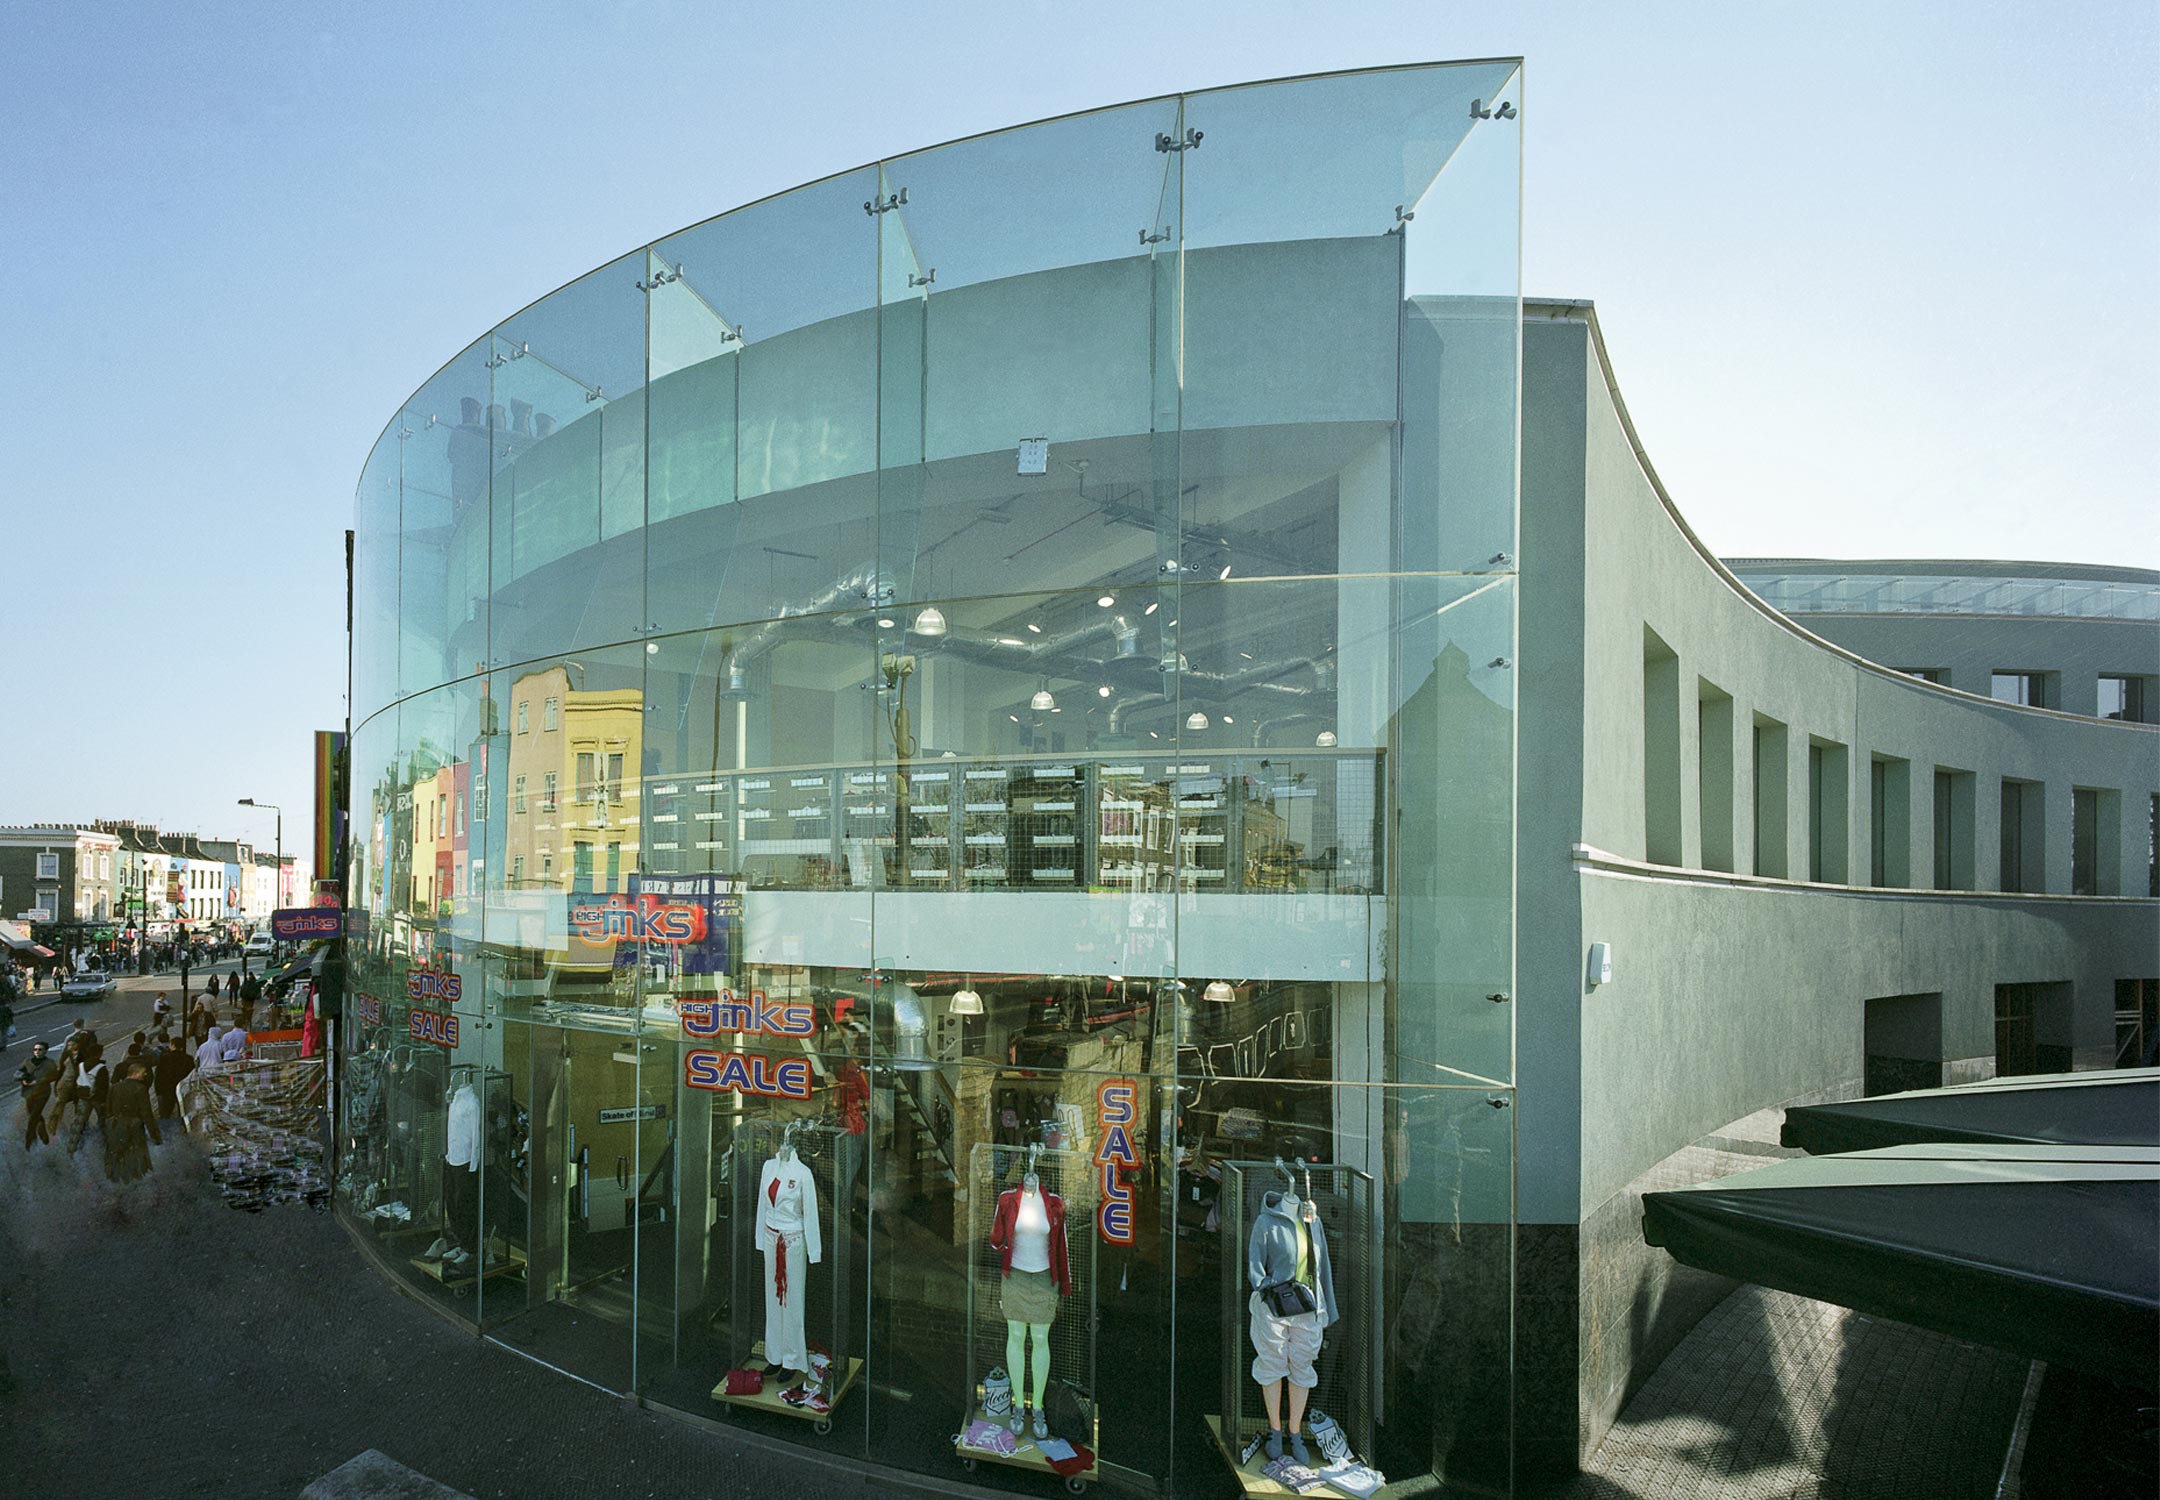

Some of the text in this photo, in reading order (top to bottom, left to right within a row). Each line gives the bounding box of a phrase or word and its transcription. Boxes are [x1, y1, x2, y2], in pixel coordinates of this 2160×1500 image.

[679, 1003, 713, 1014] HIGH
[411, 1012, 457, 1043] SALE
[689, 1053, 807, 1095] SALE
[602, 1112, 625, 1121] Skate
[626, 1110, 634, 1119] of
[1099, 1087, 1136, 1239] SALE
